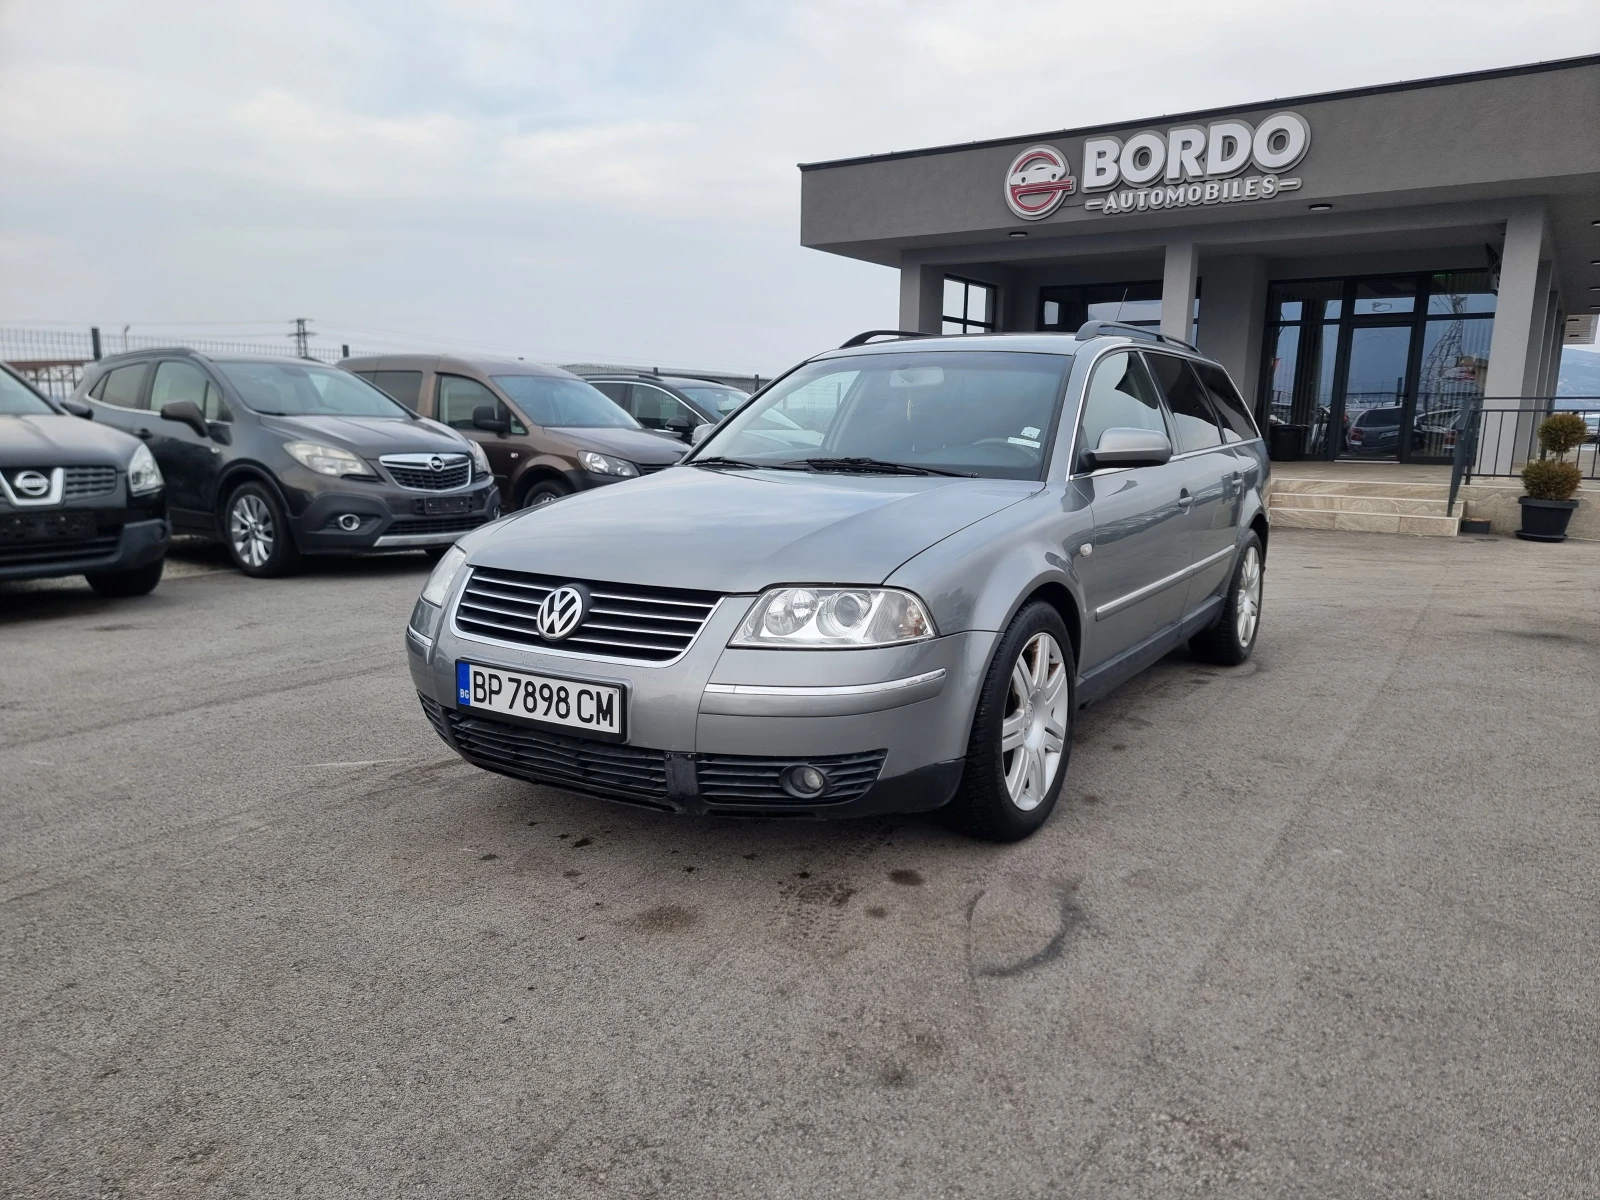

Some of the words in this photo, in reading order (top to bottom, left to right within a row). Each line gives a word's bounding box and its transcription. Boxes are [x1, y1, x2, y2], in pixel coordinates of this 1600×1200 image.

[1083, 115, 1306, 188] BORDO
[1105, 177, 1275, 210] AUTOMOBILES
[536, 587, 583, 638] VW
[460, 688, 470, 699] BG
[473, 670, 502, 705] BP
[508, 677, 571, 719] 7898
[577, 689, 614, 727] CM
